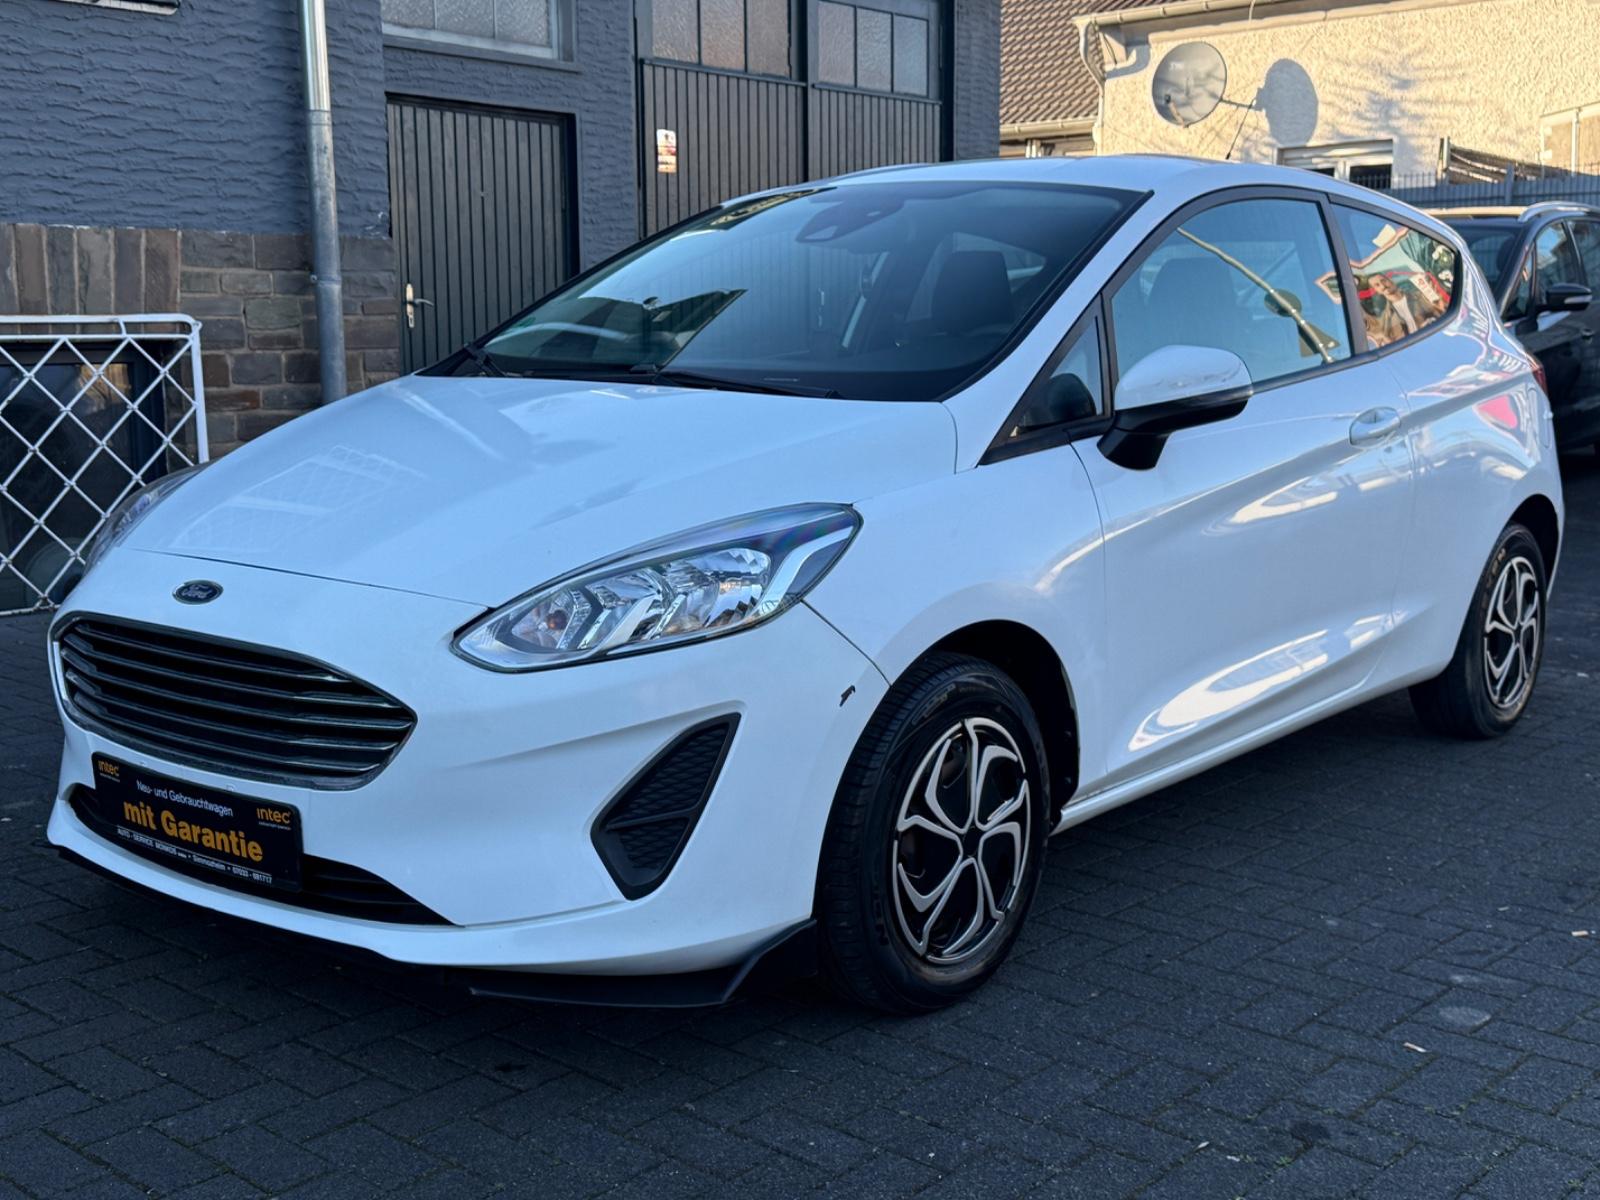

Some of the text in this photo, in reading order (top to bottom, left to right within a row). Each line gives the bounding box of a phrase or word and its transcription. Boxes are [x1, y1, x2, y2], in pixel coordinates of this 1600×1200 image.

[154, 788, 168, 799] und
[169, 789, 234, 817] Gebrauchtwagen
[257, 808, 291, 824] intec
[123, 801, 157, 831] mit
[161, 810, 263, 862] Garantie
